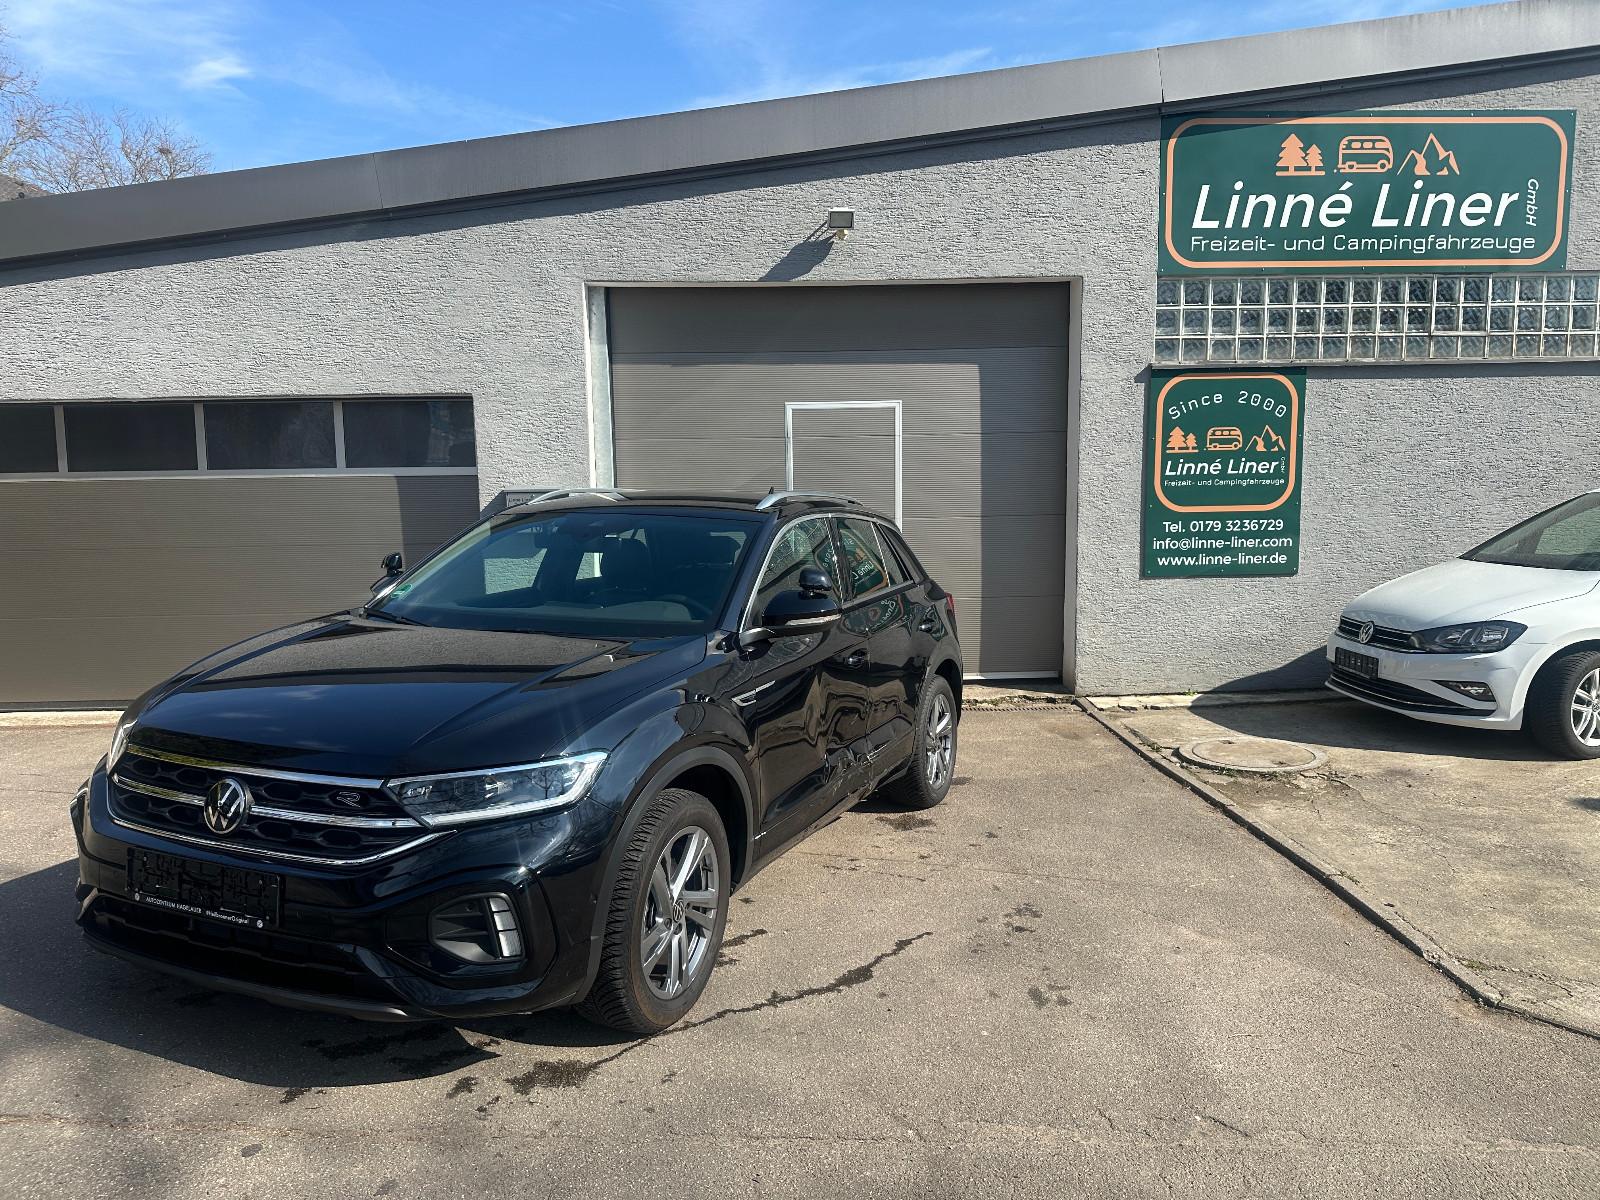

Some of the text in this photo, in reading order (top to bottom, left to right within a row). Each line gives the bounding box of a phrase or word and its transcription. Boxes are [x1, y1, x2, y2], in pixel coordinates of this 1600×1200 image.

[1191, 179, 1520, 229] Linné Liner
[1525, 178, 1540, 227] GmbH
[1190, 234, 1536, 254] Freizeit- und Campingfahrzeuge
[1168, 390, 1287, 420] Since 2000
[1164, 457, 1280, 476] Linné Liner
[1163, 518, 1284, 533] Tel. 0179 3236729
[1152, 536, 1293, 551] info@linne-liner.com
[1157, 551, 1288, 566] www.linne-liner.de
